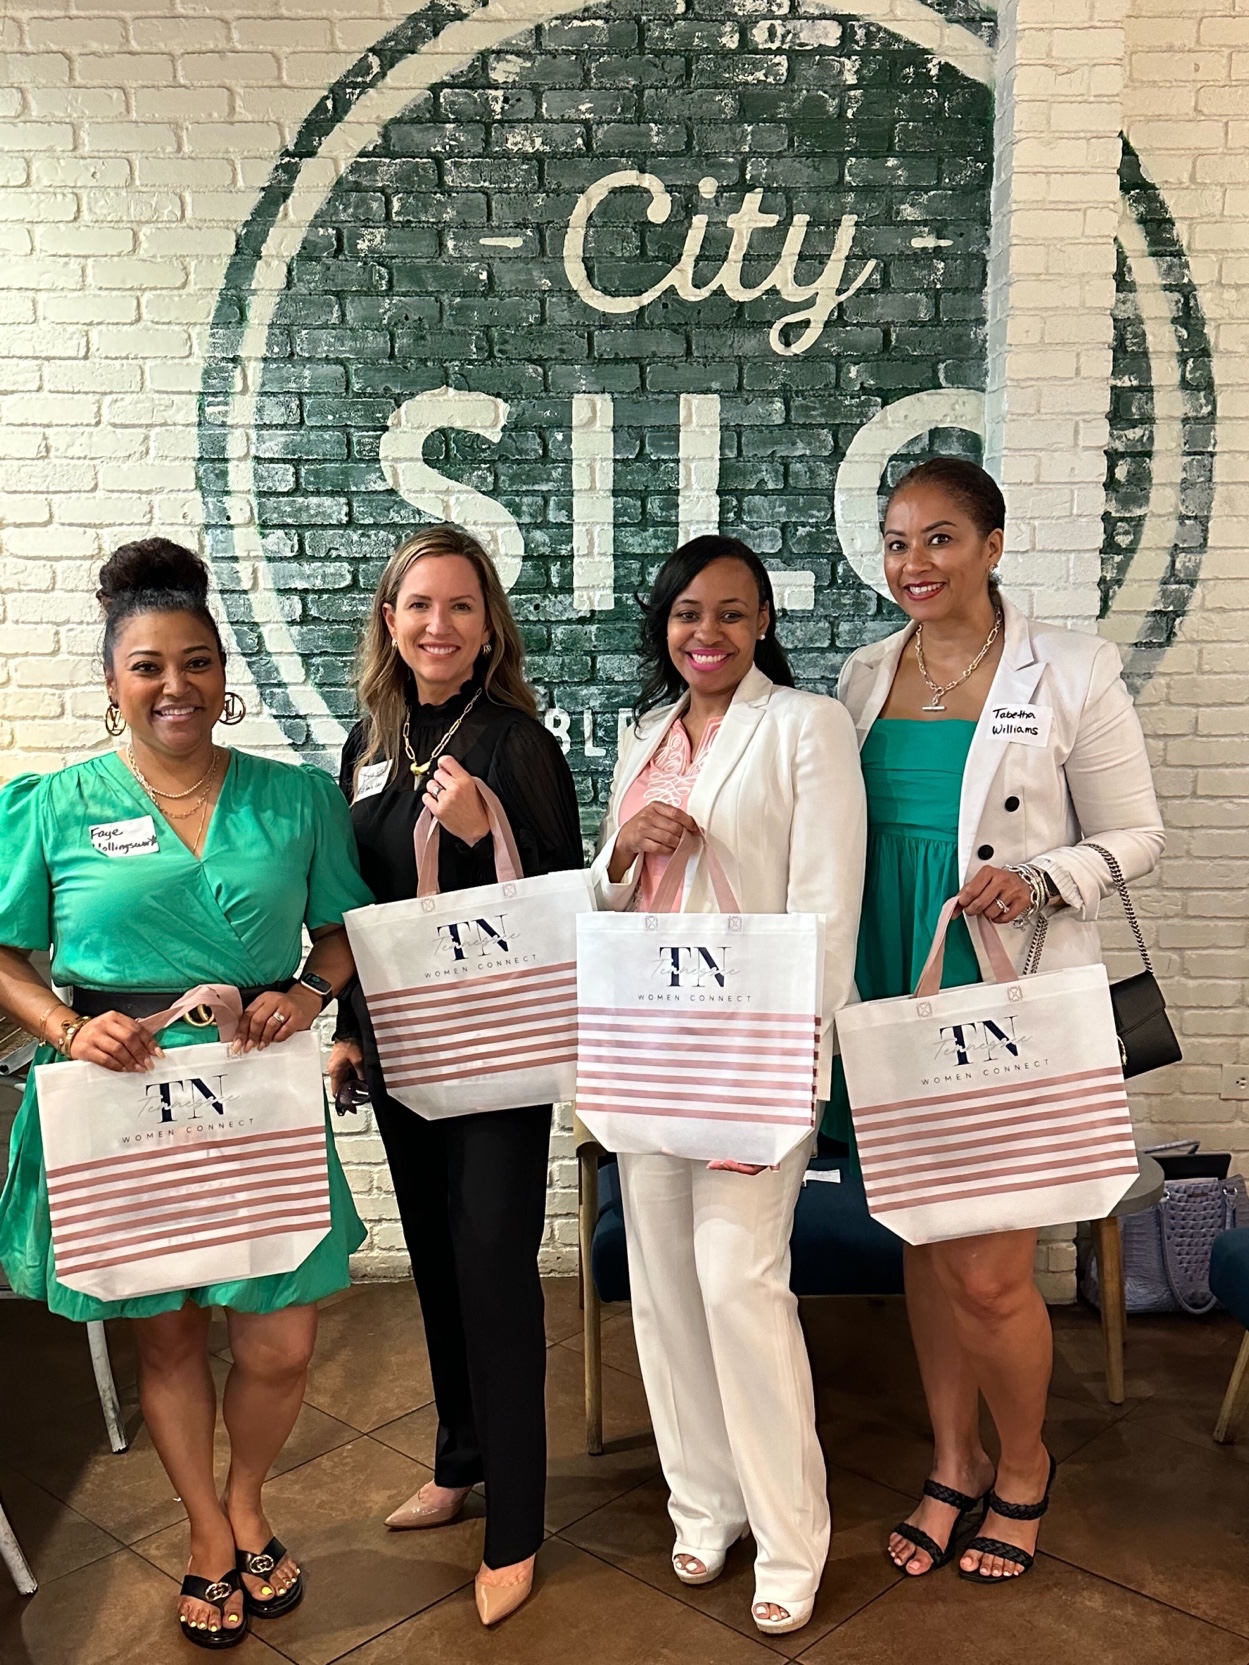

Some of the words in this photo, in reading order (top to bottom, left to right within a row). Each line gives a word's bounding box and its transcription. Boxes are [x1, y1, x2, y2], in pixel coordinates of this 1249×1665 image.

[563, 169, 877, 356] City
[992, 723, 1039, 736] Williams
[91, 827, 123, 841] Faye
[424, 966, 469, 979] WOMEN
[478, 954, 537, 970] CONNECT
[690, 995, 752, 1003] CONNECT
[921, 1072, 972, 1086] WOMEN
[983, 1059, 1049, 1076] CONNECT
[122, 1129, 175, 1144] WOMEN
[186, 1118, 254, 1134] CONNECT
